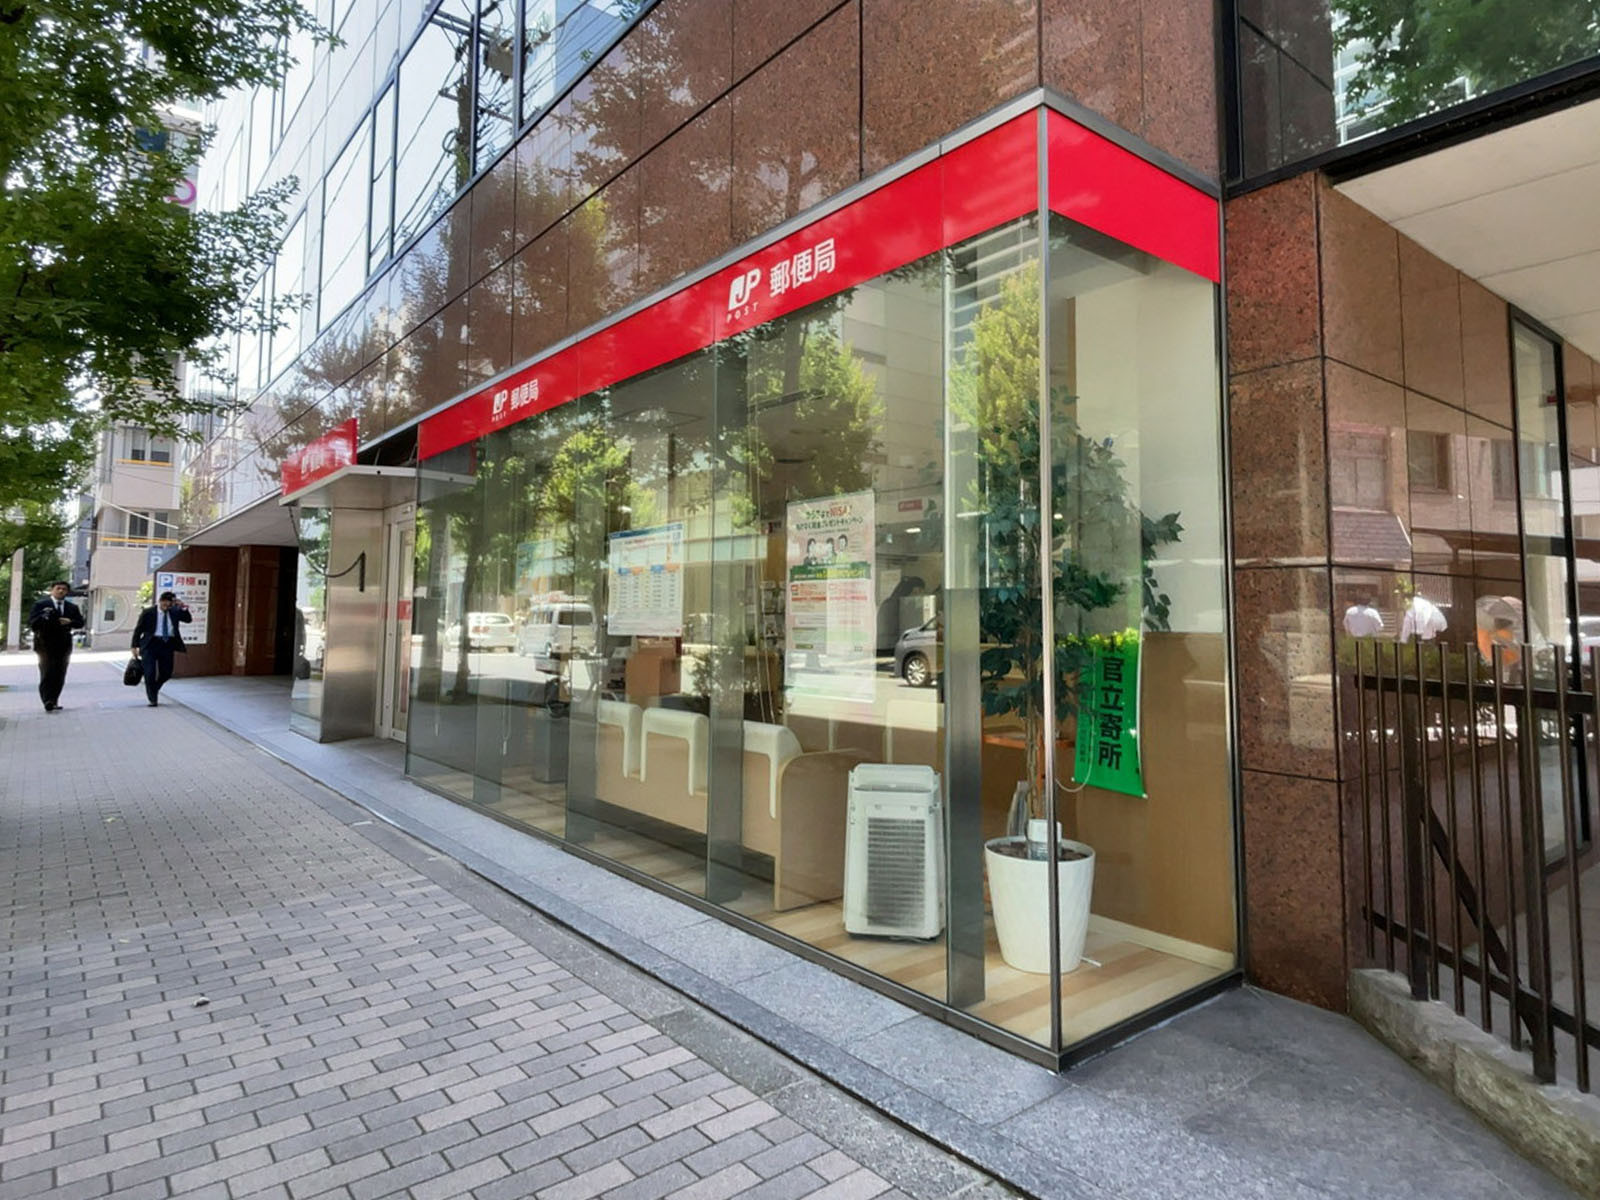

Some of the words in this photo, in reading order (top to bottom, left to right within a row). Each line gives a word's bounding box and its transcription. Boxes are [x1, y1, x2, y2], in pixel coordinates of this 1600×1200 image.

[769, 238, 836, 298] 郵便局
[727, 302, 759, 323] POST
[510, 378, 539, 411] 郵便局
[150, 556, 162, 569] P
[160, 575, 171, 586] P
